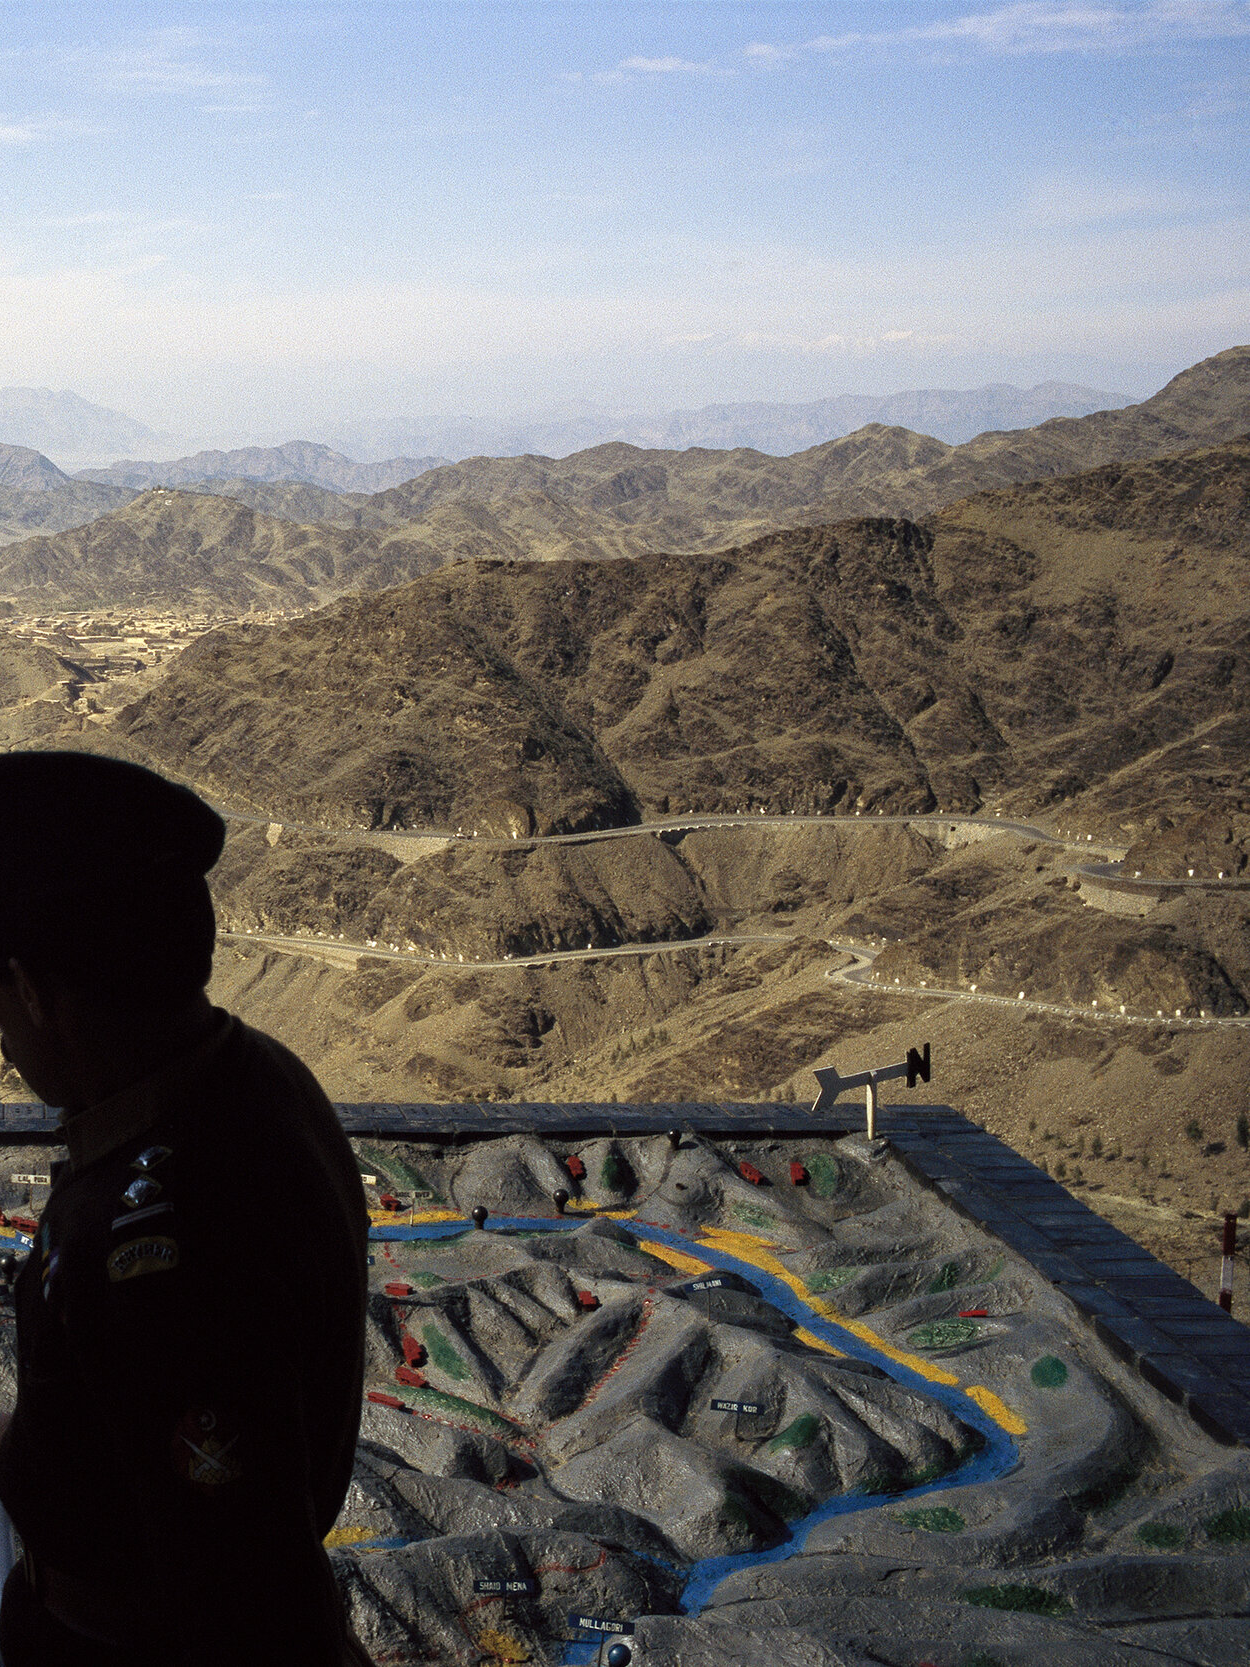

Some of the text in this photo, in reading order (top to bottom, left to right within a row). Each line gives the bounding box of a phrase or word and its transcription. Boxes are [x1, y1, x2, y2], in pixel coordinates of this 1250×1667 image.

[906, 1042, 931, 1088] N
[692, 1279, 723, 1291] SHILMANI
[505, 1581, 528, 1592] MENA
[578, 1617, 624, 1633] MULLAGORI
